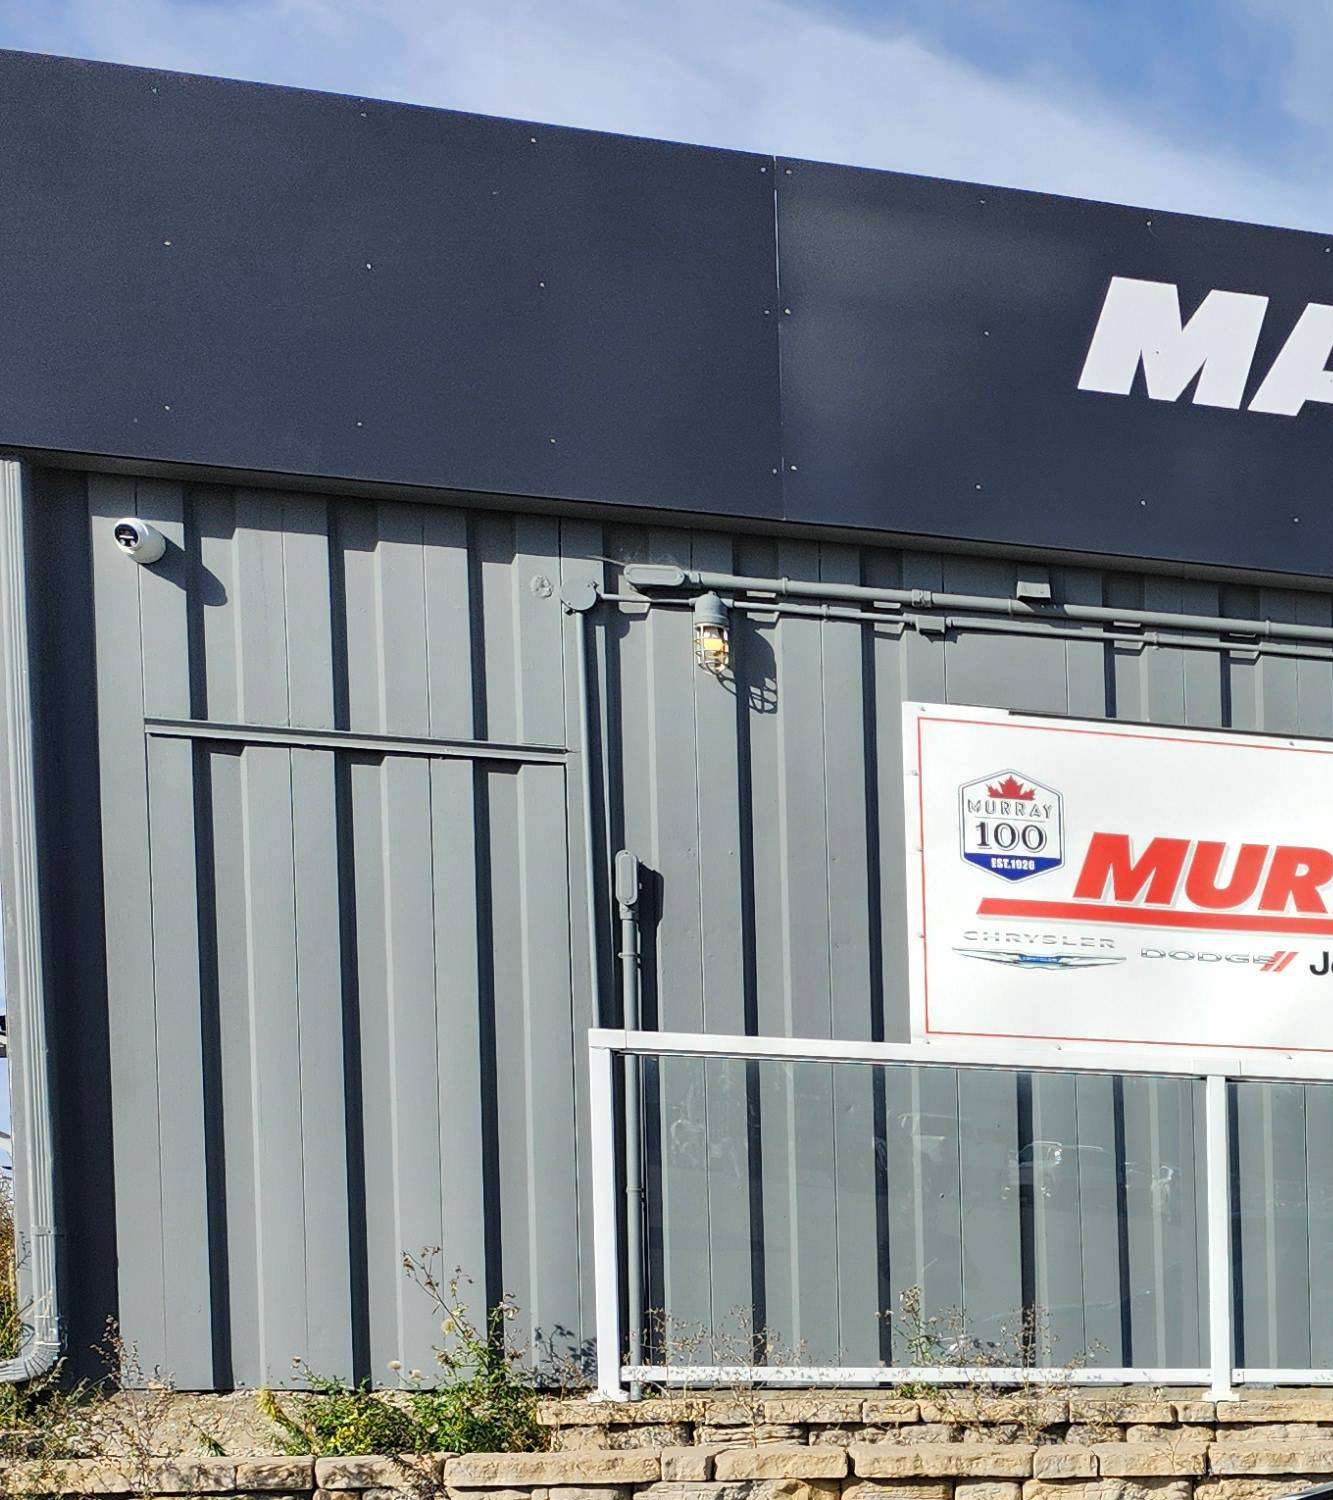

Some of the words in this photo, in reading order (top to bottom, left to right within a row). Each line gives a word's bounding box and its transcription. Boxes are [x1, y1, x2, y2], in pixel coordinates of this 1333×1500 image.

[967, 798, 1052, 819] MURRAY
[975, 821, 1048, 853] 100
[963, 930, 1115, 949] CHRYSLER
[1141, 947, 1277, 964] DODGE
